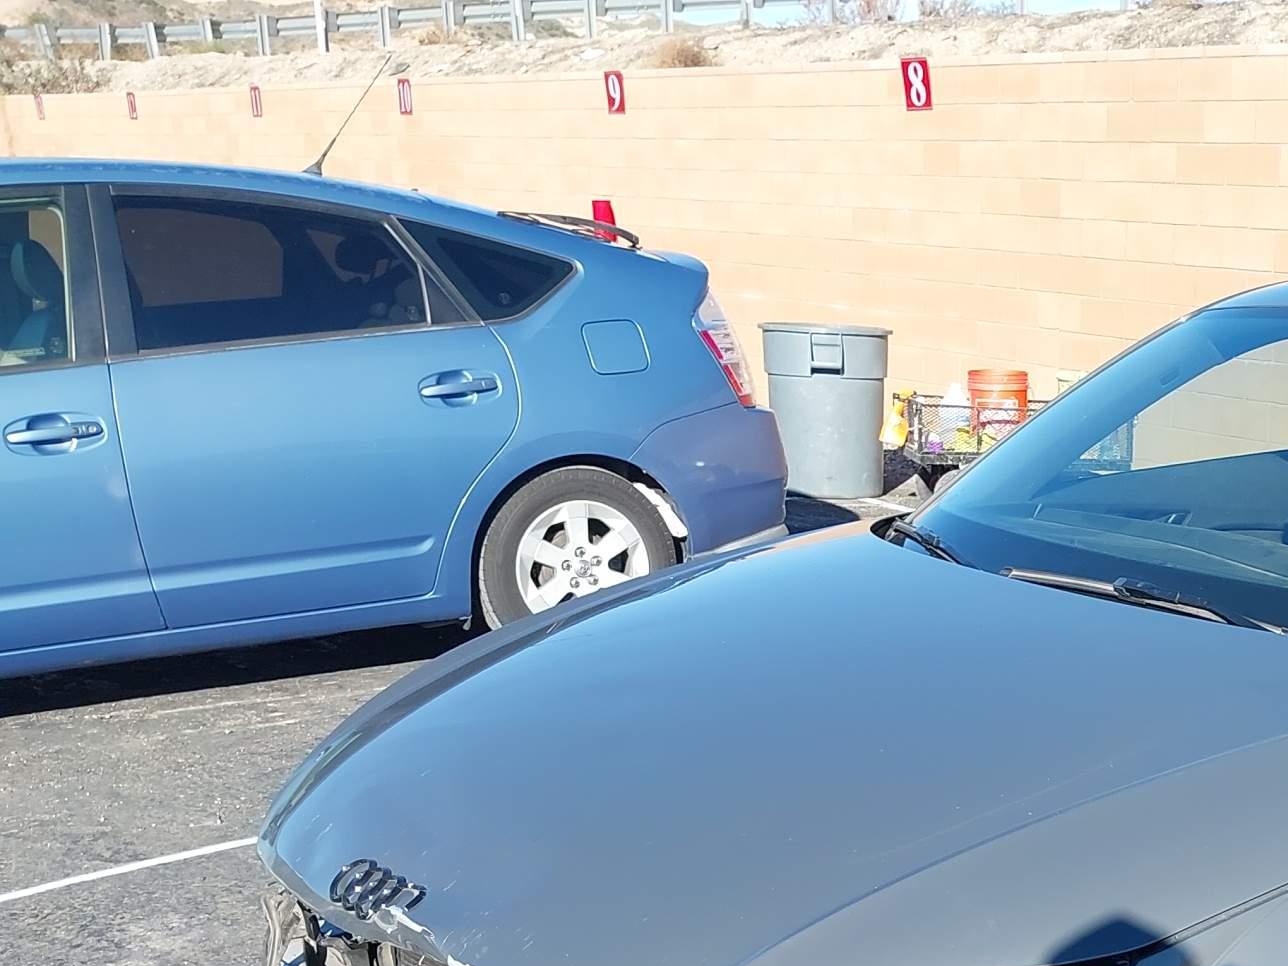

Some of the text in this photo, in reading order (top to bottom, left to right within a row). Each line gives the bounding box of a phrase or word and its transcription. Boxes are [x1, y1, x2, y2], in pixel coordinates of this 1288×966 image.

[399, 81, 411, 113] 10
[608, 75, 621, 111] 9
[907, 61, 927, 107] 8
